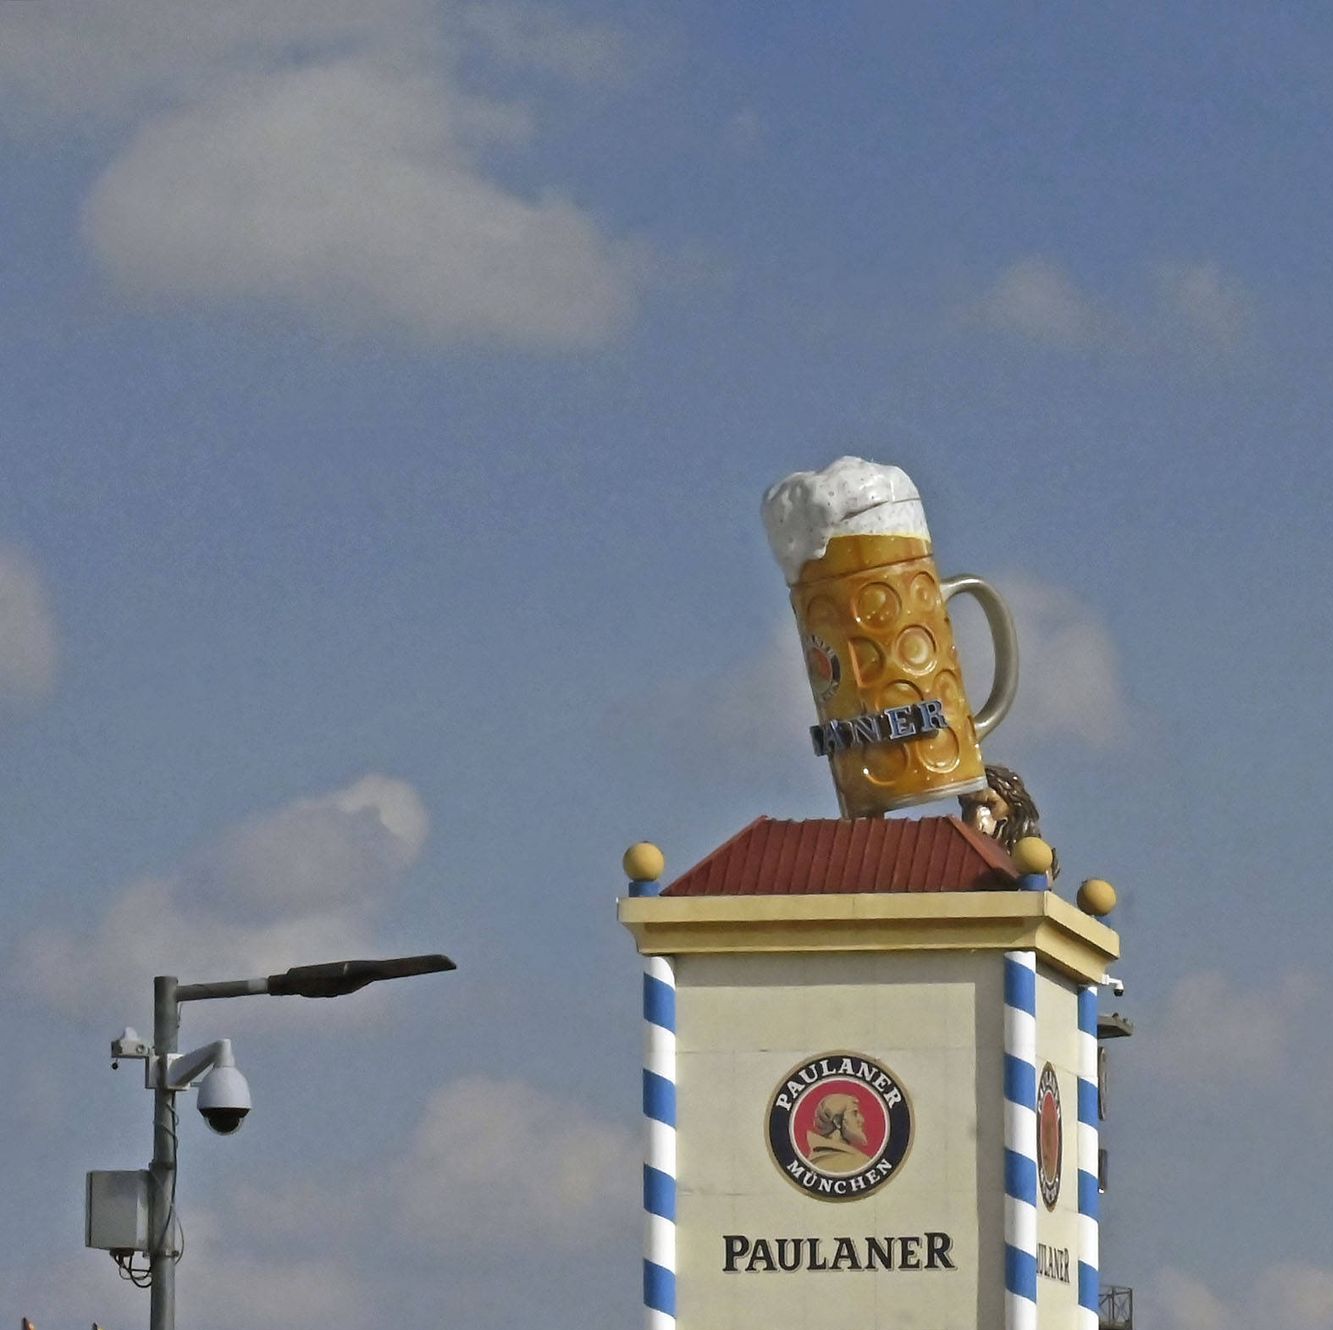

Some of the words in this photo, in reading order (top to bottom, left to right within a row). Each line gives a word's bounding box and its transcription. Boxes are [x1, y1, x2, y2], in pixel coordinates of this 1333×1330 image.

[810, 698, 949, 757] ANER
[775, 1056, 902, 1112] PAULANER
[785, 1157, 894, 1196] MÜNCHEN
[722, 1232, 958, 1272] PAULANER
